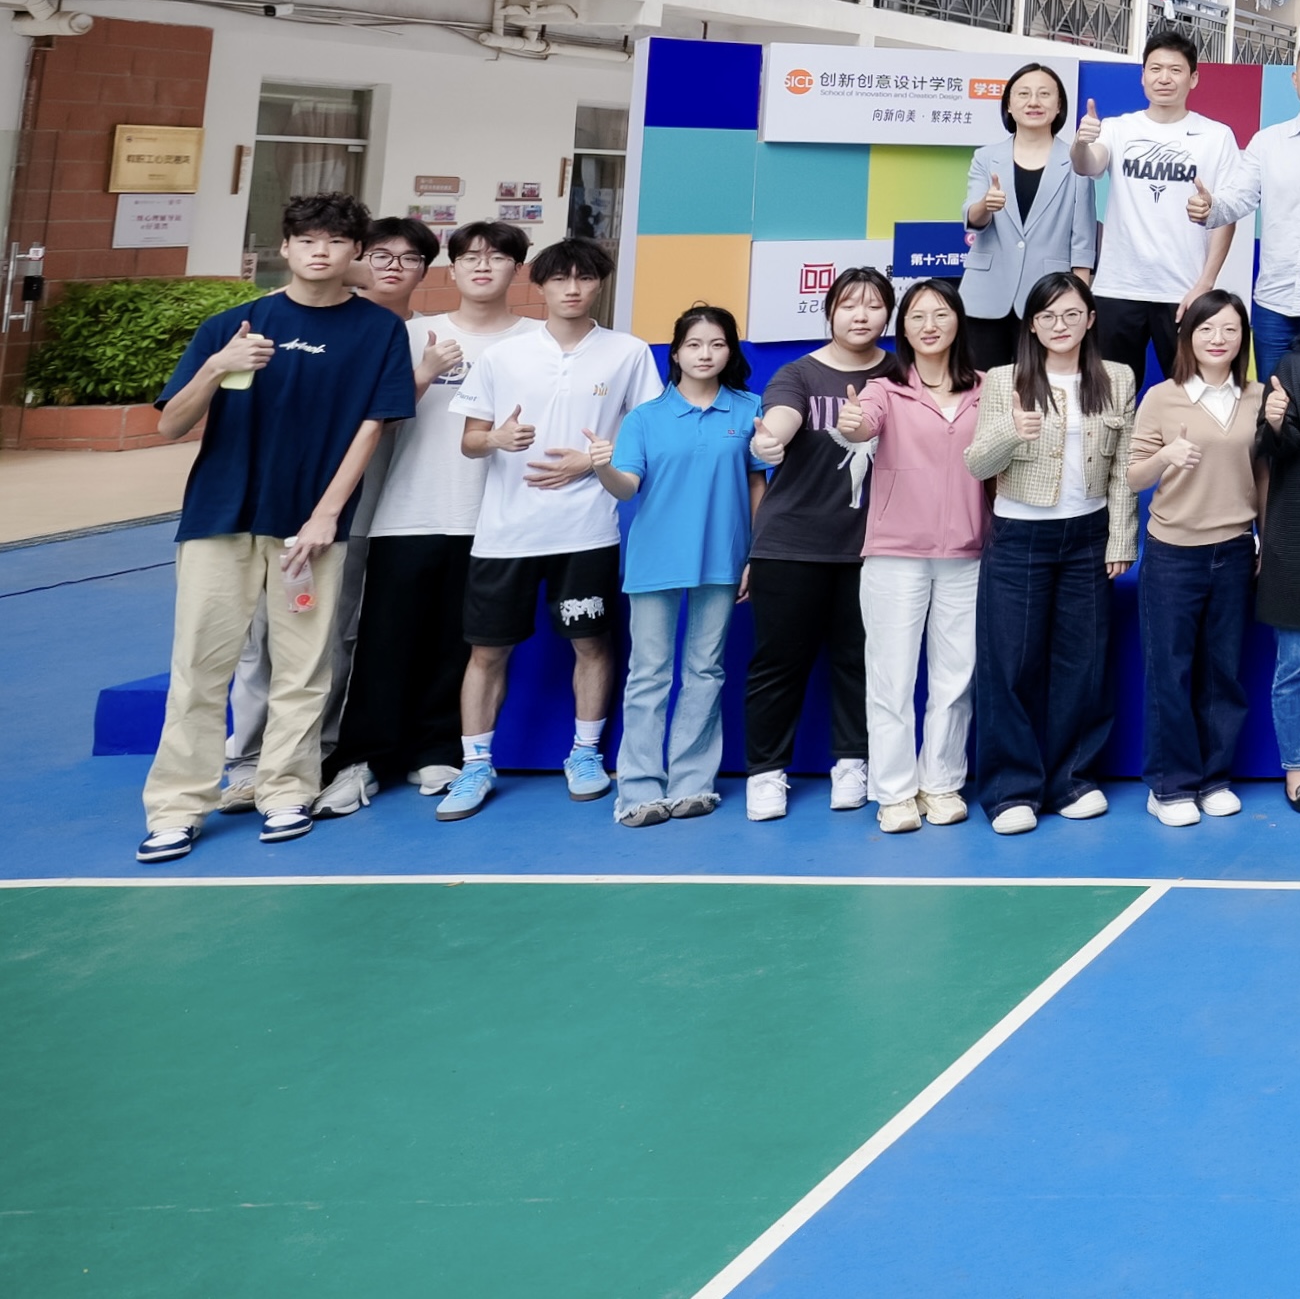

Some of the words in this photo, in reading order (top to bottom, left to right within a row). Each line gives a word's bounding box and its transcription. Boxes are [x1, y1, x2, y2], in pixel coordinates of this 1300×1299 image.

[820, 71, 963, 92] 创新创意设计学院
[973, 82, 1005, 96] 学生
[820, 89, 845, 97] School
[855, 90, 892, 98] Innovation
[938, 93, 962, 101] Design
[1122, 158, 1197, 184] MAMBA
[910, 253, 968, 267] 第十六届学
